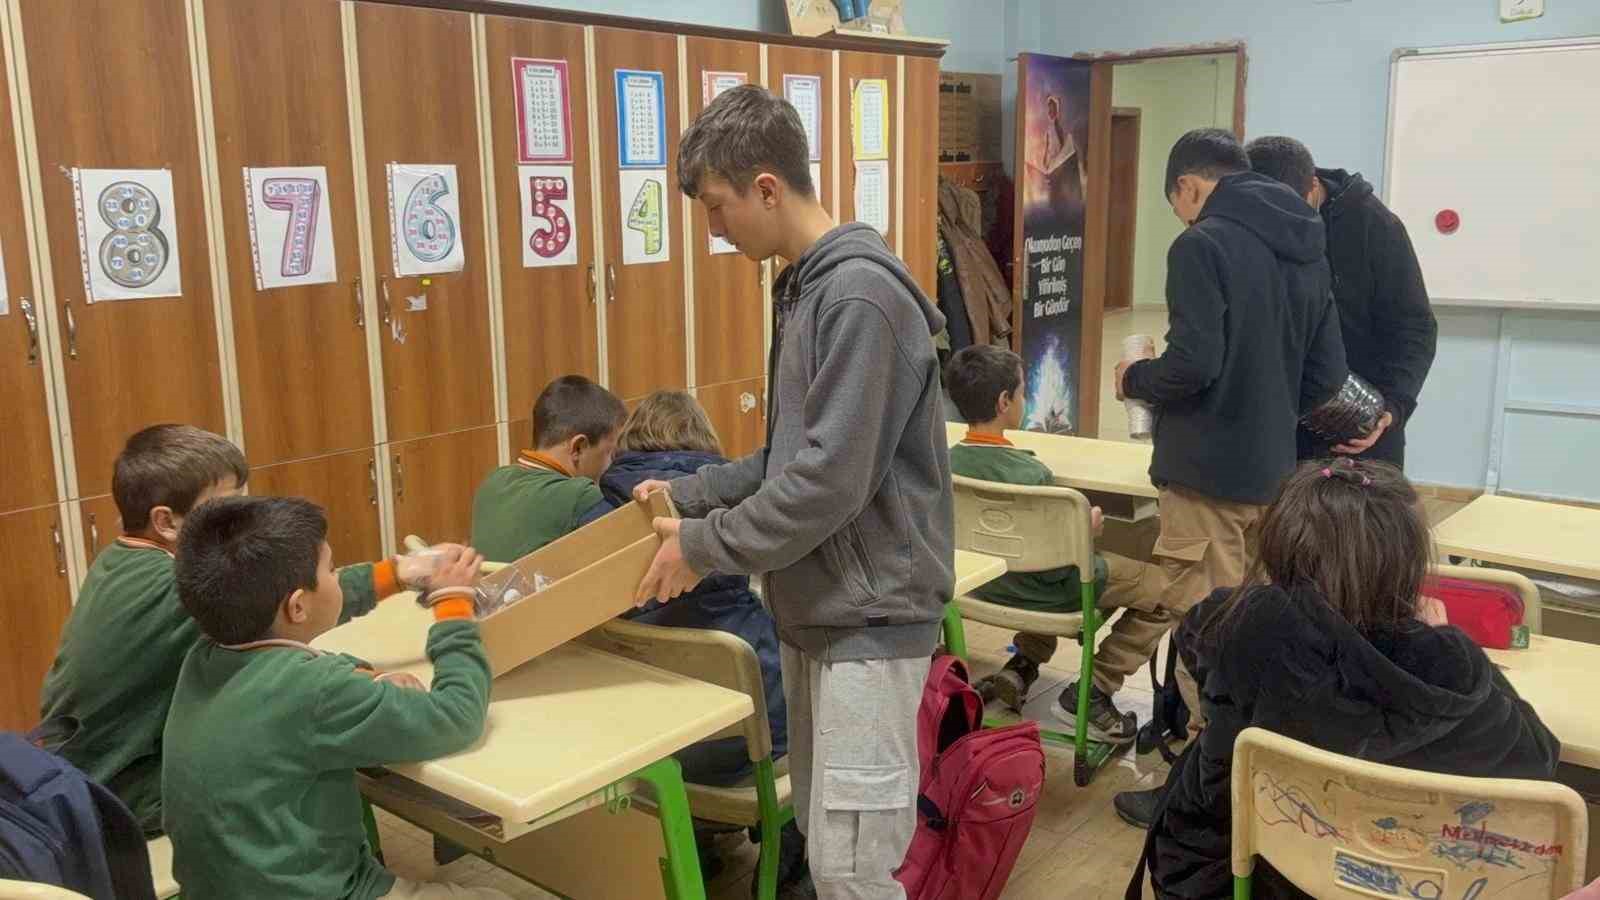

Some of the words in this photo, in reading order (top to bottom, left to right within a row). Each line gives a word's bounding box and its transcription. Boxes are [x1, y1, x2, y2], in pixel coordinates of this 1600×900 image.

[98, 181, 169, 288] 8
[263, 178, 321, 277] 7
[403, 173, 455, 262] 6
[530, 176, 570, 258] 5
[627, 178, 662, 255] 4
[1040, 257, 1051, 274] Bir
[1033, 301, 1045, 318] Bir
